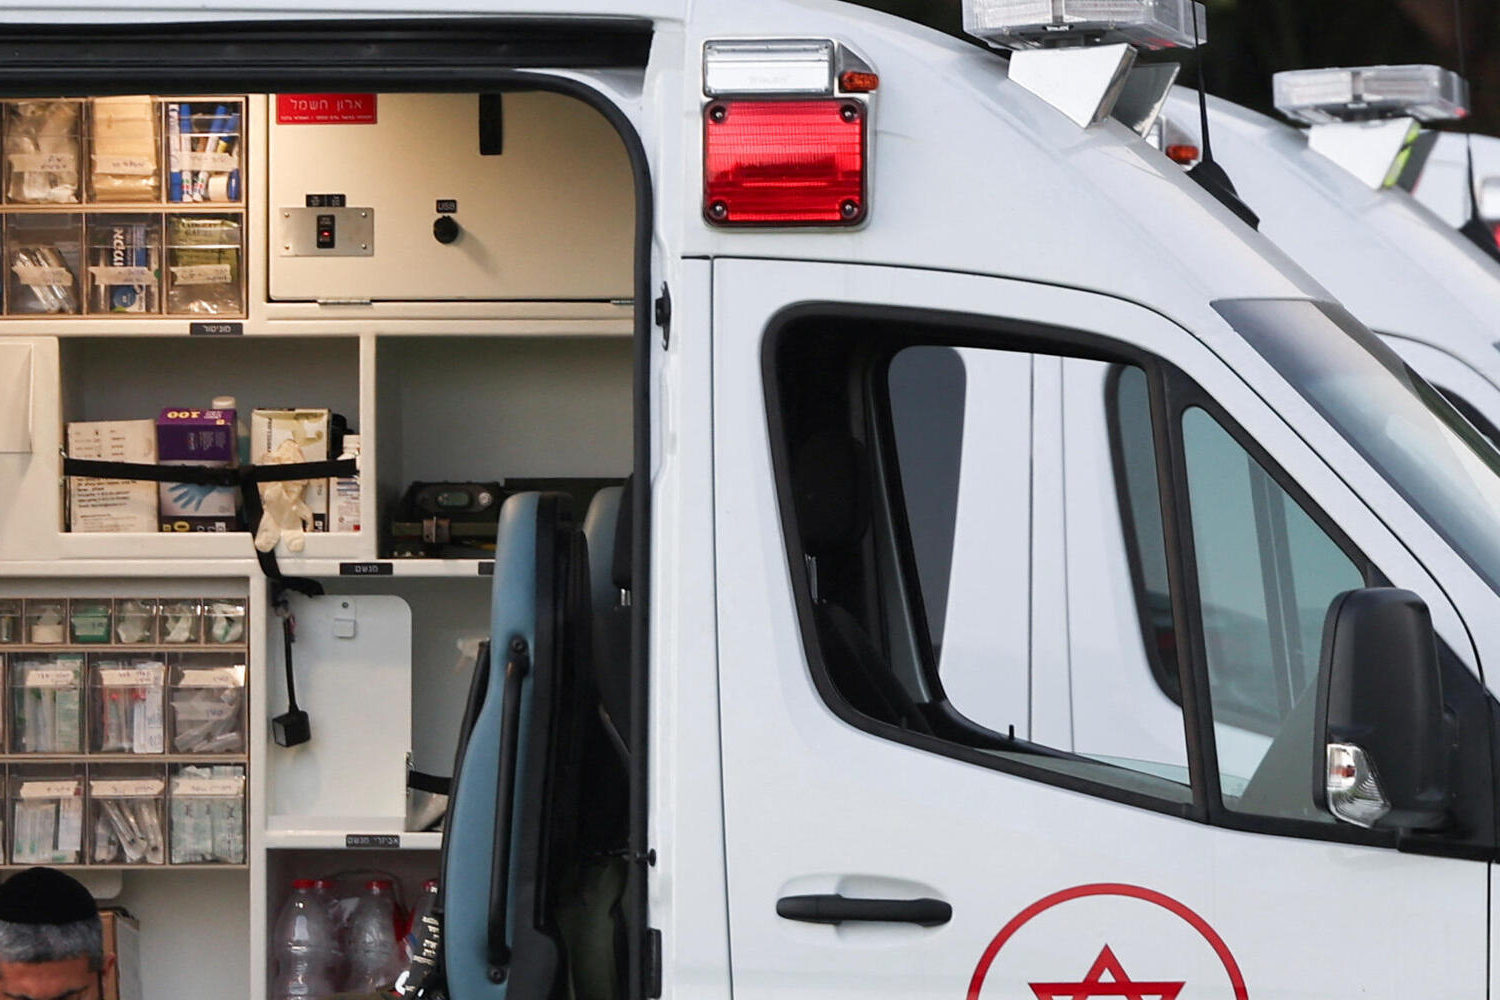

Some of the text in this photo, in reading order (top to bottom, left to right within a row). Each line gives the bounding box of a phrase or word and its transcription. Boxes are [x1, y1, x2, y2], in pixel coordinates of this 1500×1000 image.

[290, 98, 363, 111] ארון חשמל
[437, 202, 456, 211] USB
